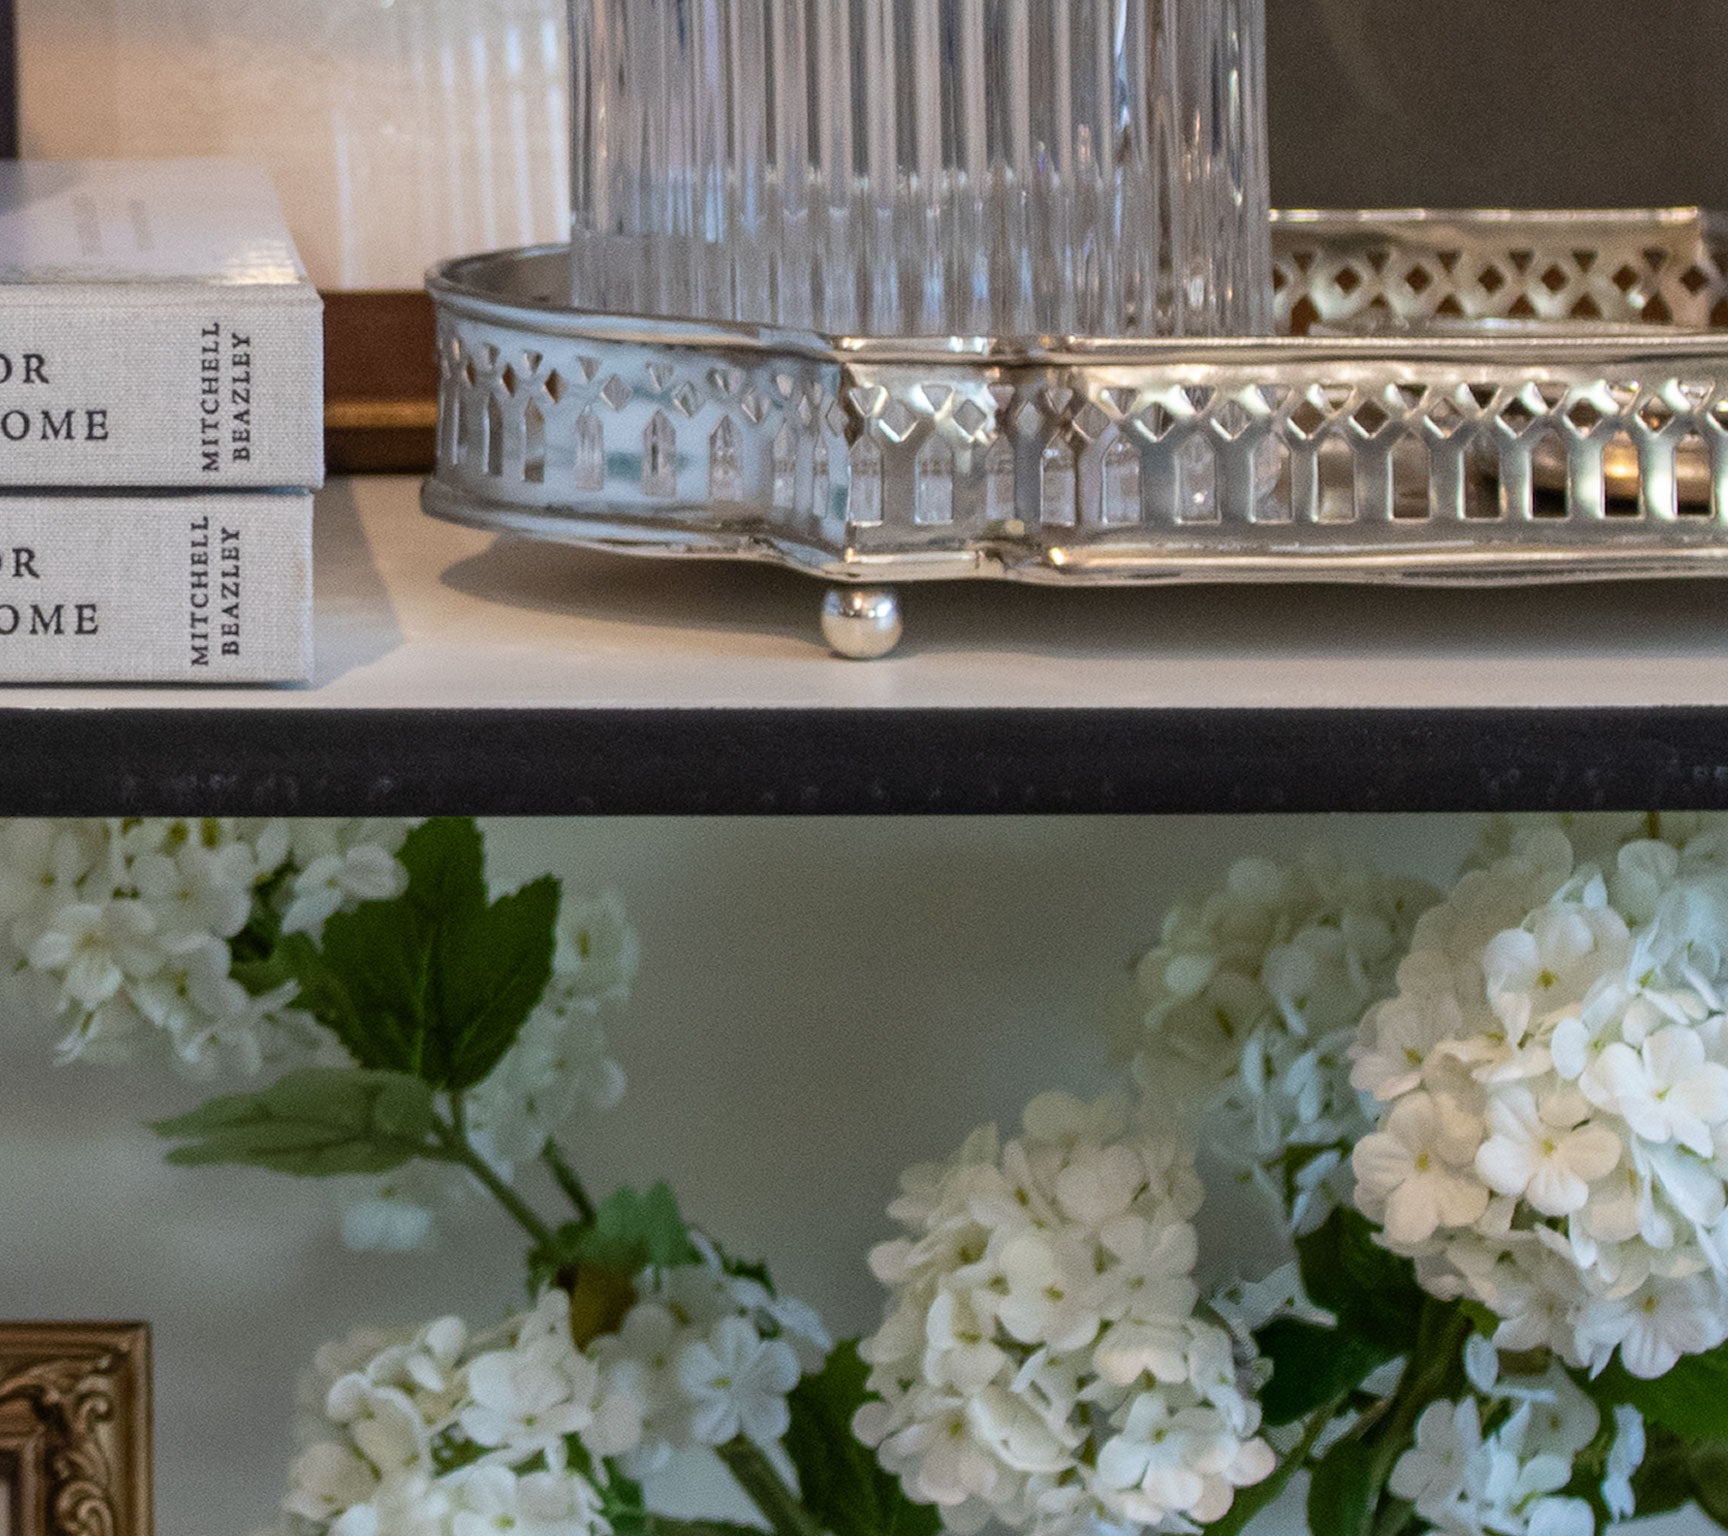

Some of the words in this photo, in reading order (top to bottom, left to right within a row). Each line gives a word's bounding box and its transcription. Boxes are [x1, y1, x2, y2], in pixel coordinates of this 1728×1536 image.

[199, 321, 221, 473] MITCHELL
[230, 332, 252, 462] BEAZLEY
[189, 515, 210, 667] MITCHELL
[220, 526, 241, 657] BEAZLEY
